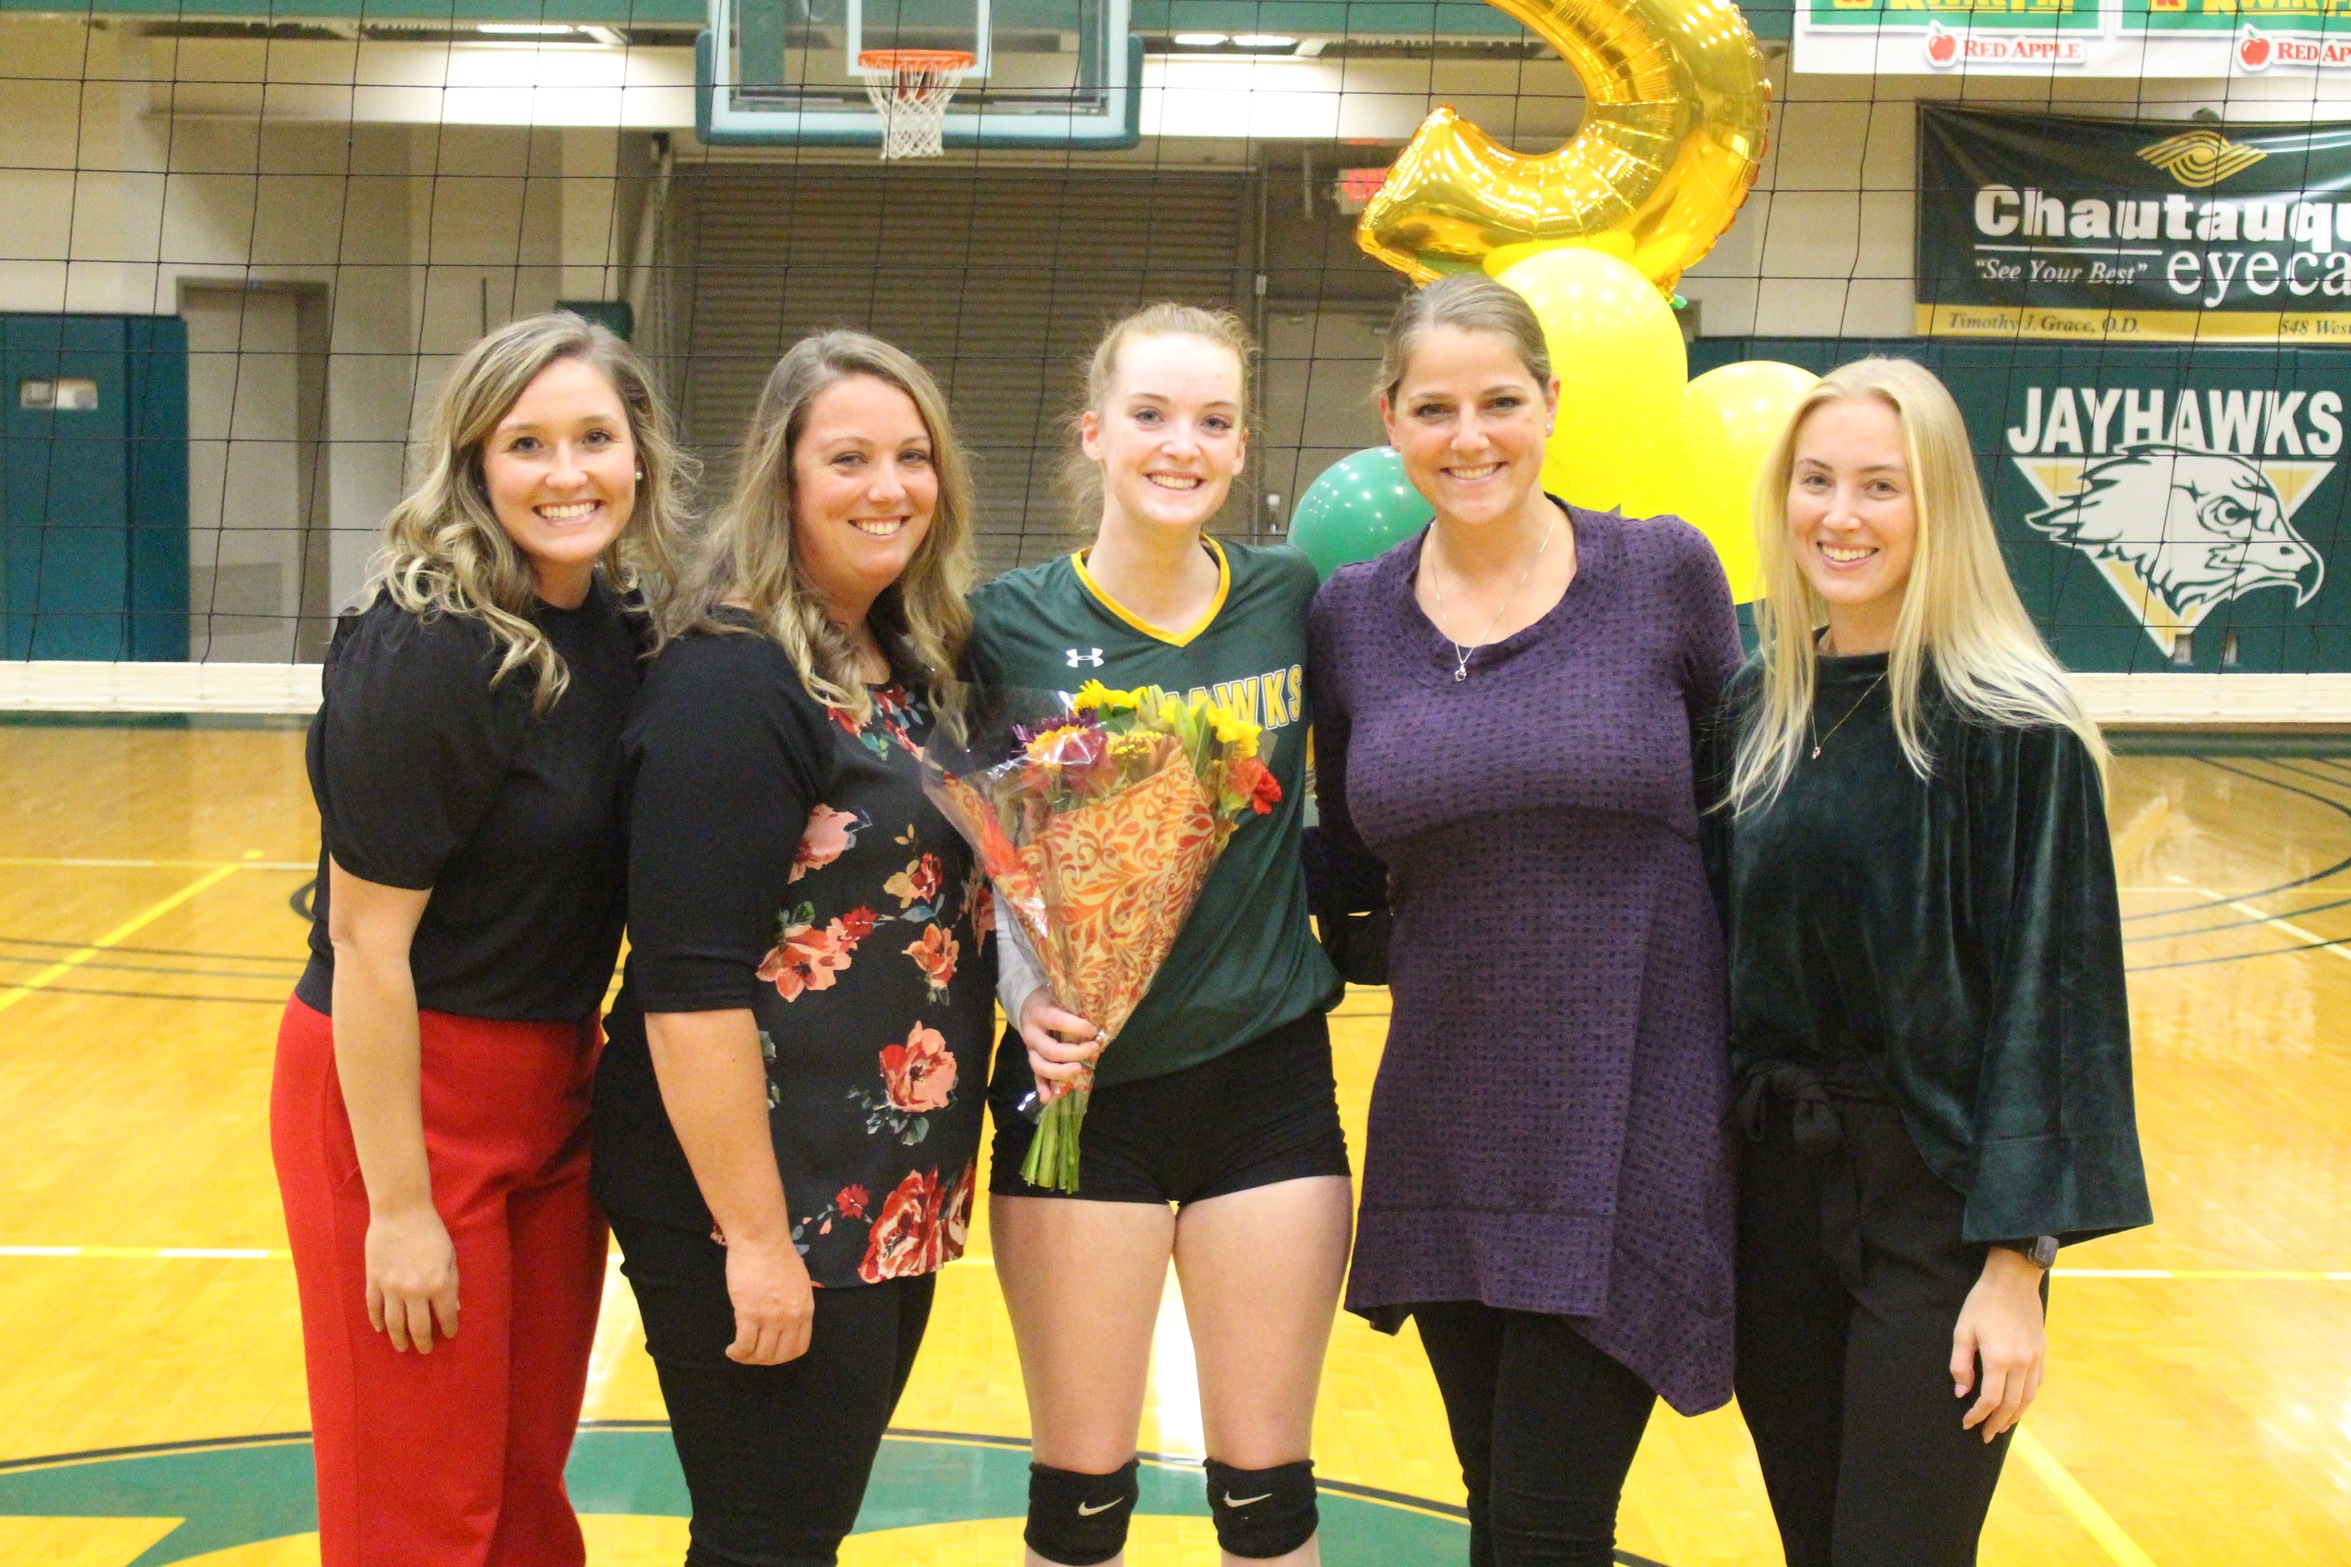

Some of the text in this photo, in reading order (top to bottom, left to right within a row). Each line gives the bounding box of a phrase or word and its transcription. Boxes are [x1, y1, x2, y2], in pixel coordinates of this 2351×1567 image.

[1964, 39, 2081, 59] RED APPLE
[2277, 42, 2319, 61] RED
[2029, 259, 2083, 283] Your
[1949, 312, 2020, 335] Timothy
[2280, 320, 2309, 335] 548
[2007, 387, 2344, 458] JAYHAWKS
